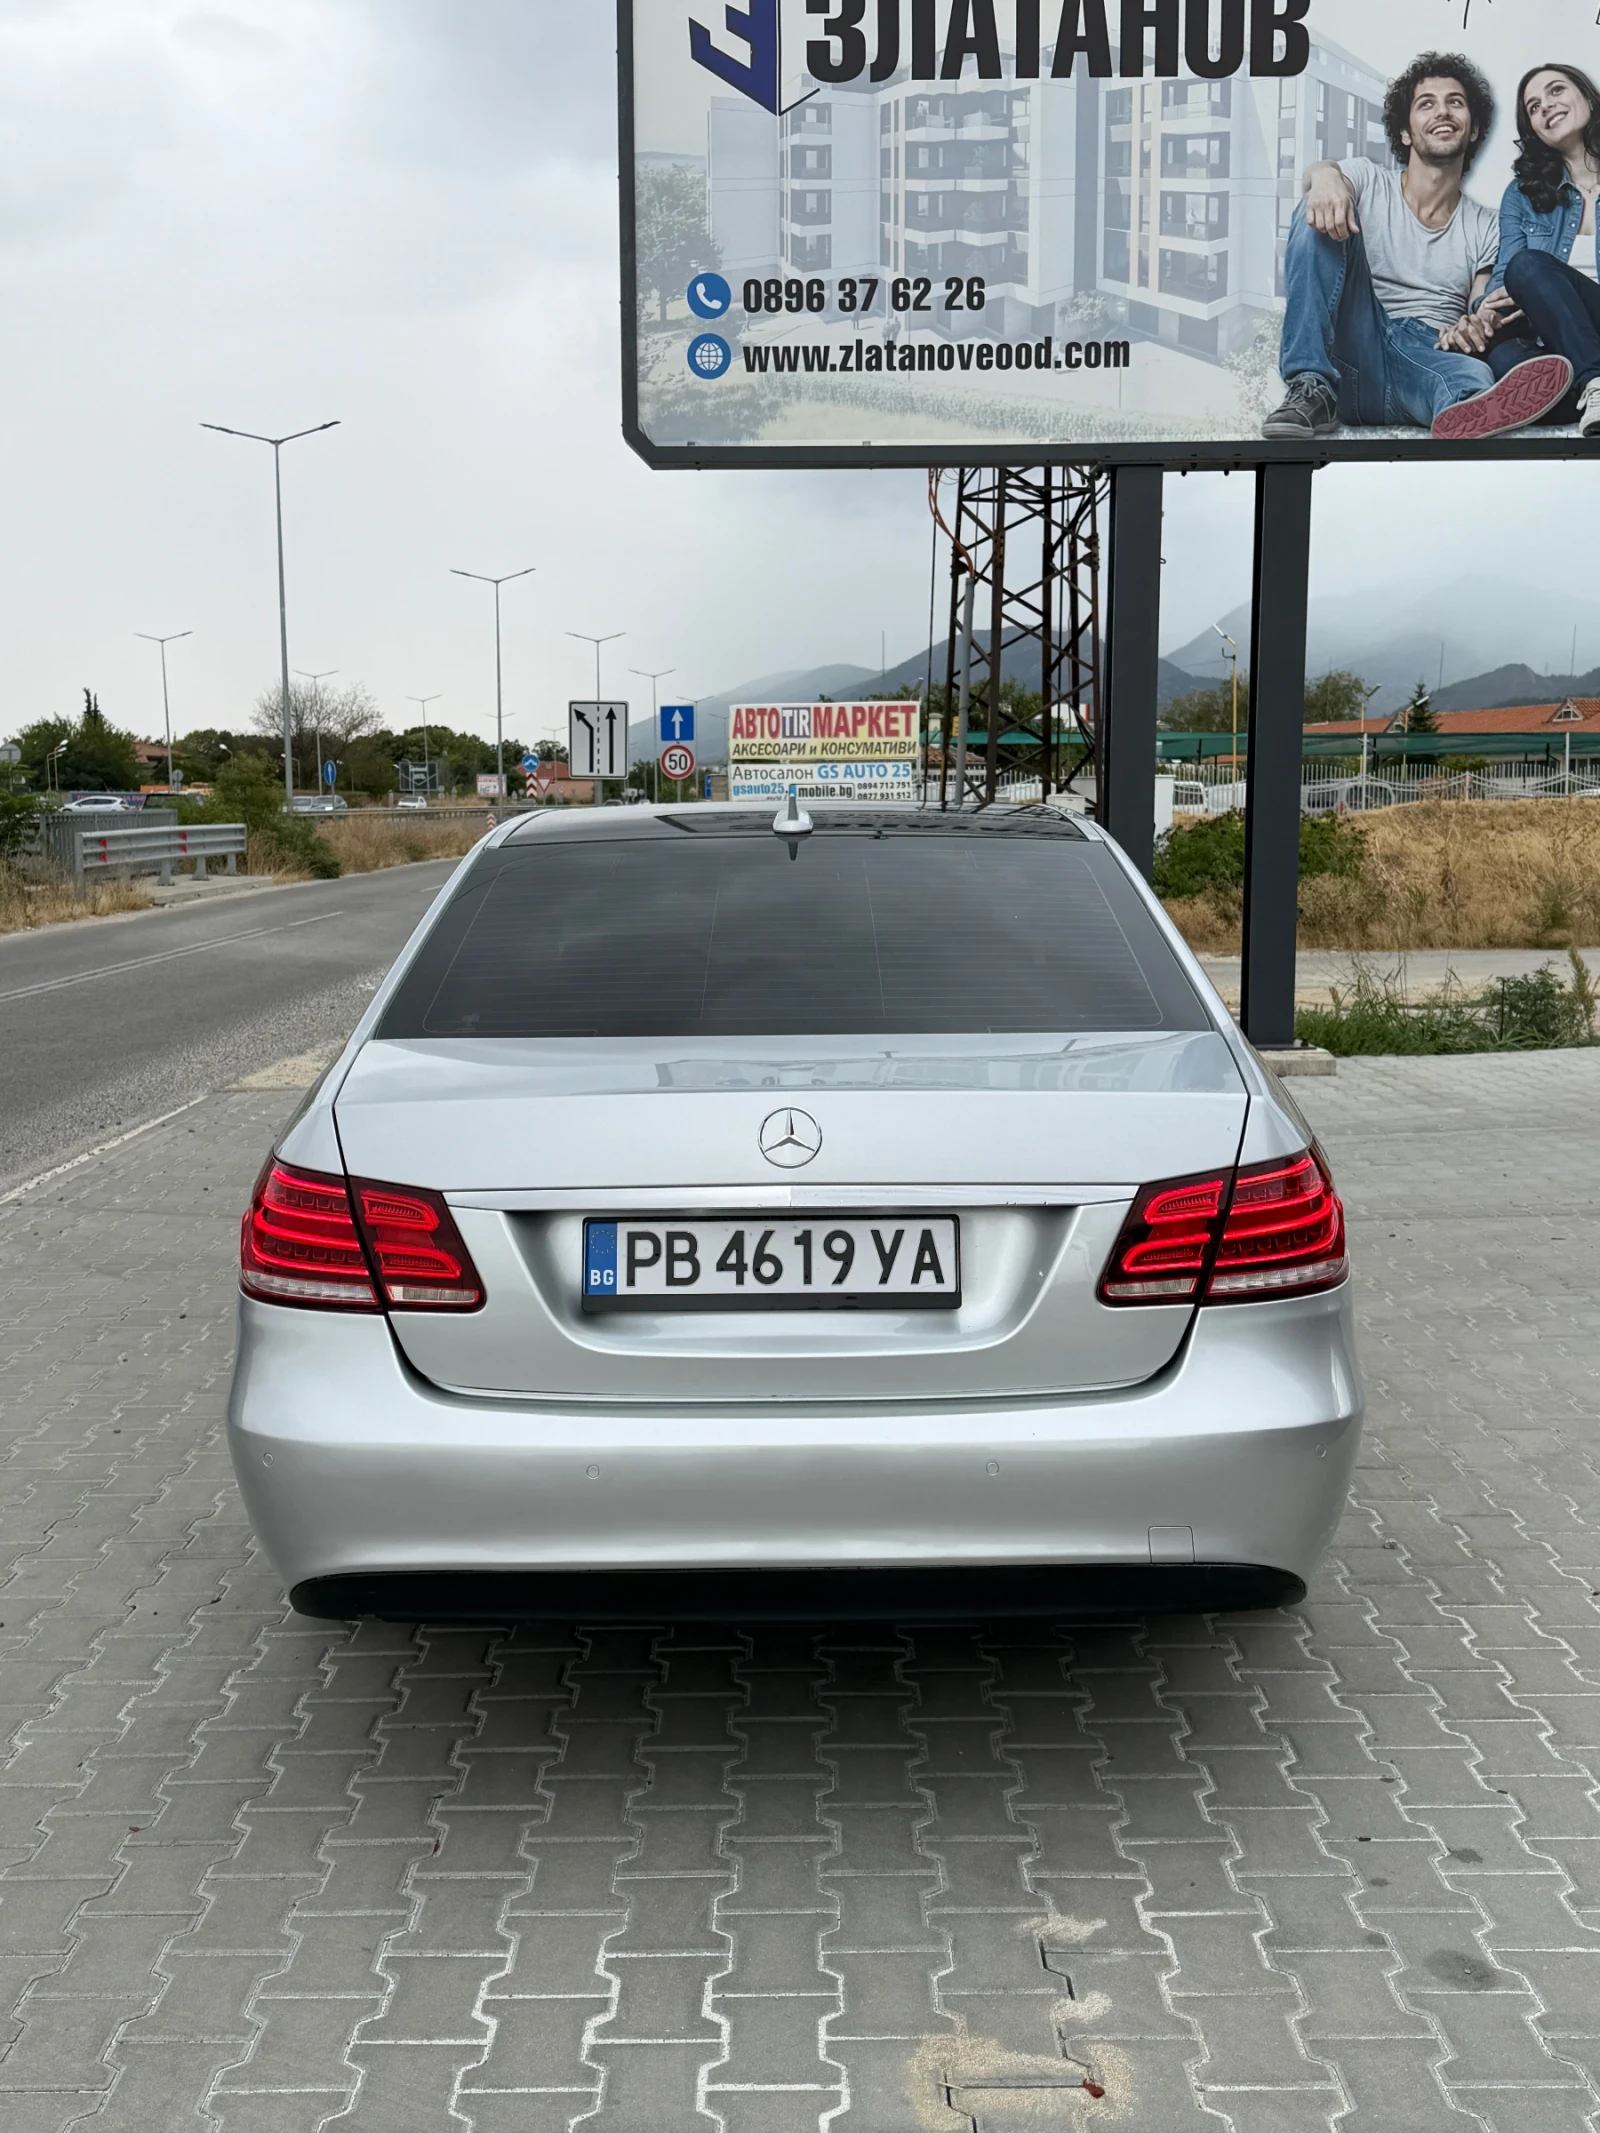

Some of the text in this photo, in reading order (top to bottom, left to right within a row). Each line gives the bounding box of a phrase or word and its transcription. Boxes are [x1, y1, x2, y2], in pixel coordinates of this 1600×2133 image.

[743, 276, 986, 313] 0896 37 62 26
[743, 336, 1131, 373] www.zlatanoveood.com
[732, 705, 917, 739] АВТО TIR МАРКЕТ
[732, 741, 917, 757] АКСЕСОАРИ и КОНСУМАТИВИ
[668, 753, 688, 771] 50
[732, 763, 911, 781] Автосалон GS AUTO 25
[798, 784, 853, 798] mobile.bg
[857, 782, 878, 790] 0894
[879, 781, 894, 789] 712
[857, 791, 911, 800] 0877 931 512
[626, 1230, 701, 1288] PB
[716, 1229, 855, 1286] 4619
[590, 1269, 615, 1286] BG
